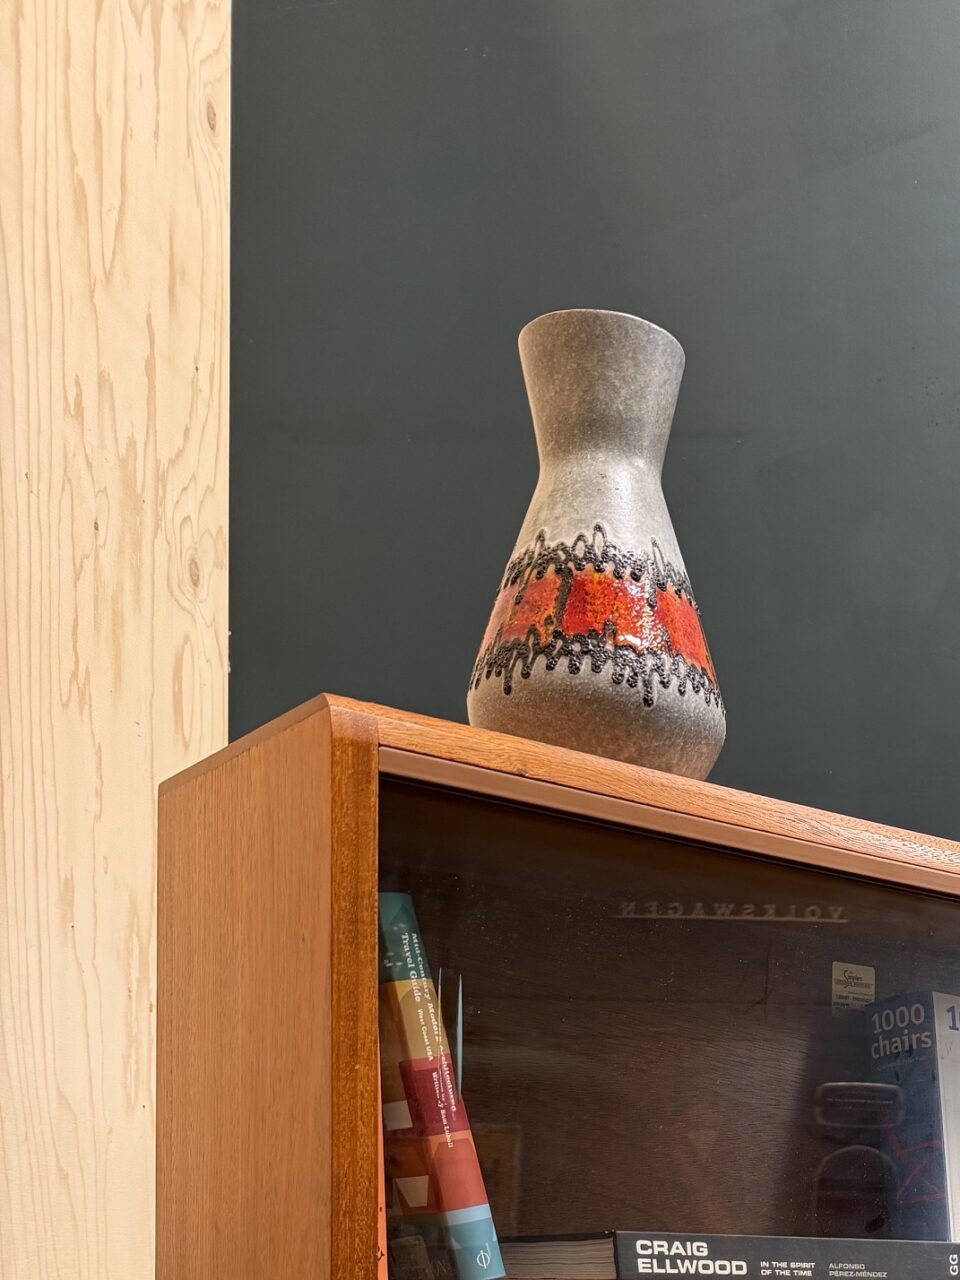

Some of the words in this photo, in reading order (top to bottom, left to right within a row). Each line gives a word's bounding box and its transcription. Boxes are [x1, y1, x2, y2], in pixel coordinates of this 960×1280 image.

[402, 932, 415, 968] Travel
[409, 970, 421, 1002] Guide
[871, 1003, 925, 1034] 1000
[426, 1045, 434, 1061] USA
[871, 1030, 932, 1059] chairs
[636, 1240, 709, 1257] CRAIG
[637, 1259, 748, 1276] ELLWOOD
[949, 1254, 958, 1275] GG
